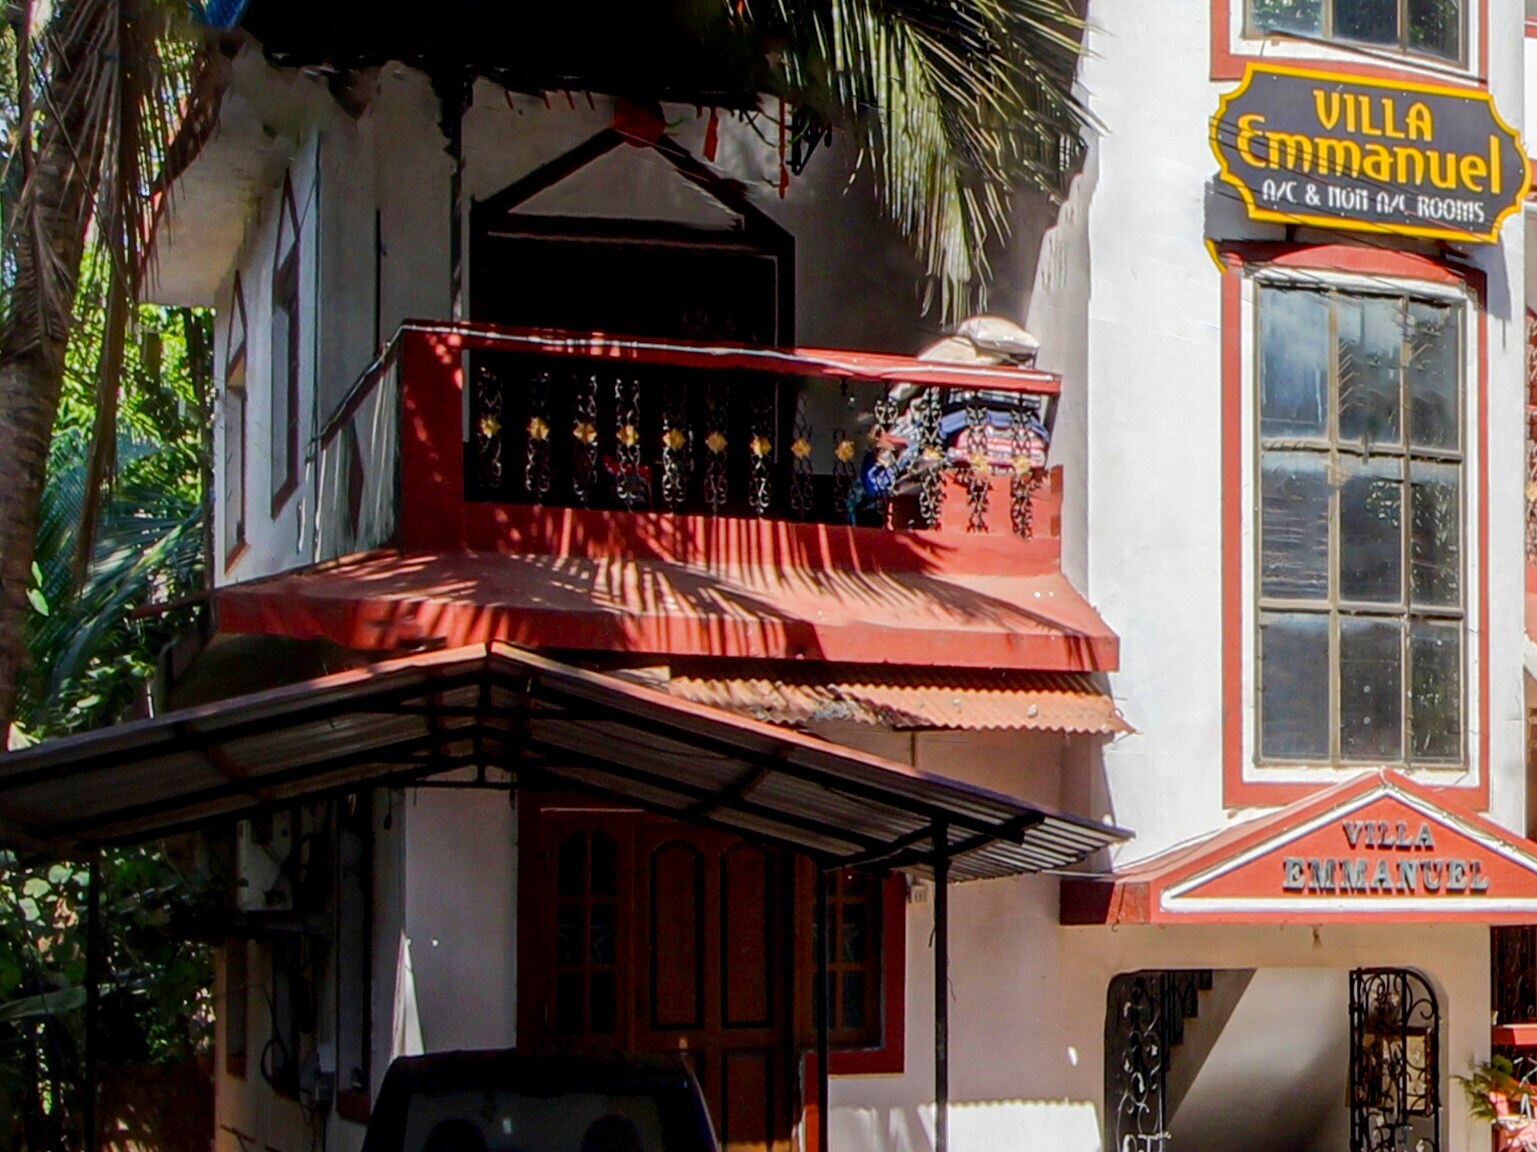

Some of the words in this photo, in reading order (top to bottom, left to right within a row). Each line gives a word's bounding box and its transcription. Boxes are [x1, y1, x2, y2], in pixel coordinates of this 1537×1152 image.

[1313, 89, 1433, 141] VILLA
[1236, 114, 1500, 194] Emmanuel
[1262, 178, 1298, 204] A/C
[1305, 184, 1321, 206] &
[1327, 186, 1369, 212] NON
[1376, 191, 1409, 215] A/C
[1417, 196, 1485, 223] ROOMS
[1342, 819, 1435, 850] VILLA
[1282, 856, 1490, 894] EMMANUEL
